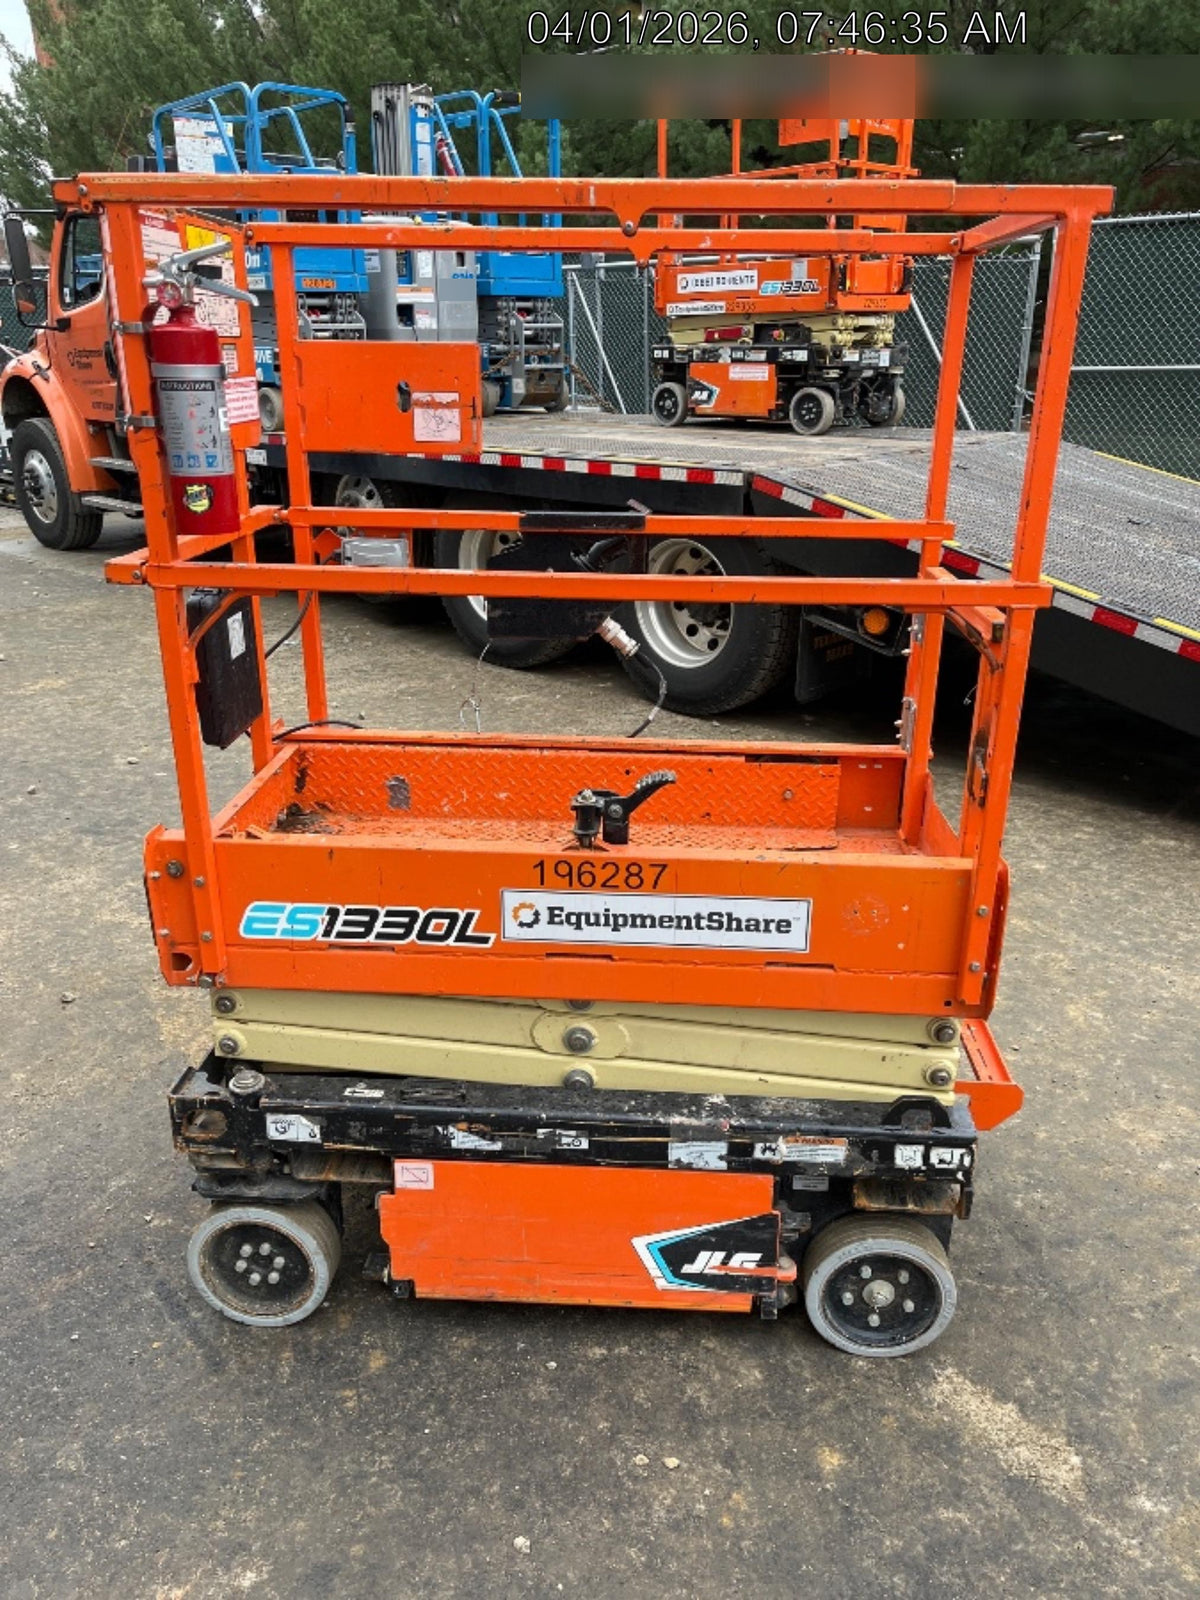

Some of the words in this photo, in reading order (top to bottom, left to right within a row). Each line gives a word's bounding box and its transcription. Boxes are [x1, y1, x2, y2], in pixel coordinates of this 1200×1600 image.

[533, 859, 669, 890] 196287
[241, 902, 495, 946] ES1330L
[546, 905, 793, 934] EquipmentShare
[680, 1250, 763, 1276] JLG
